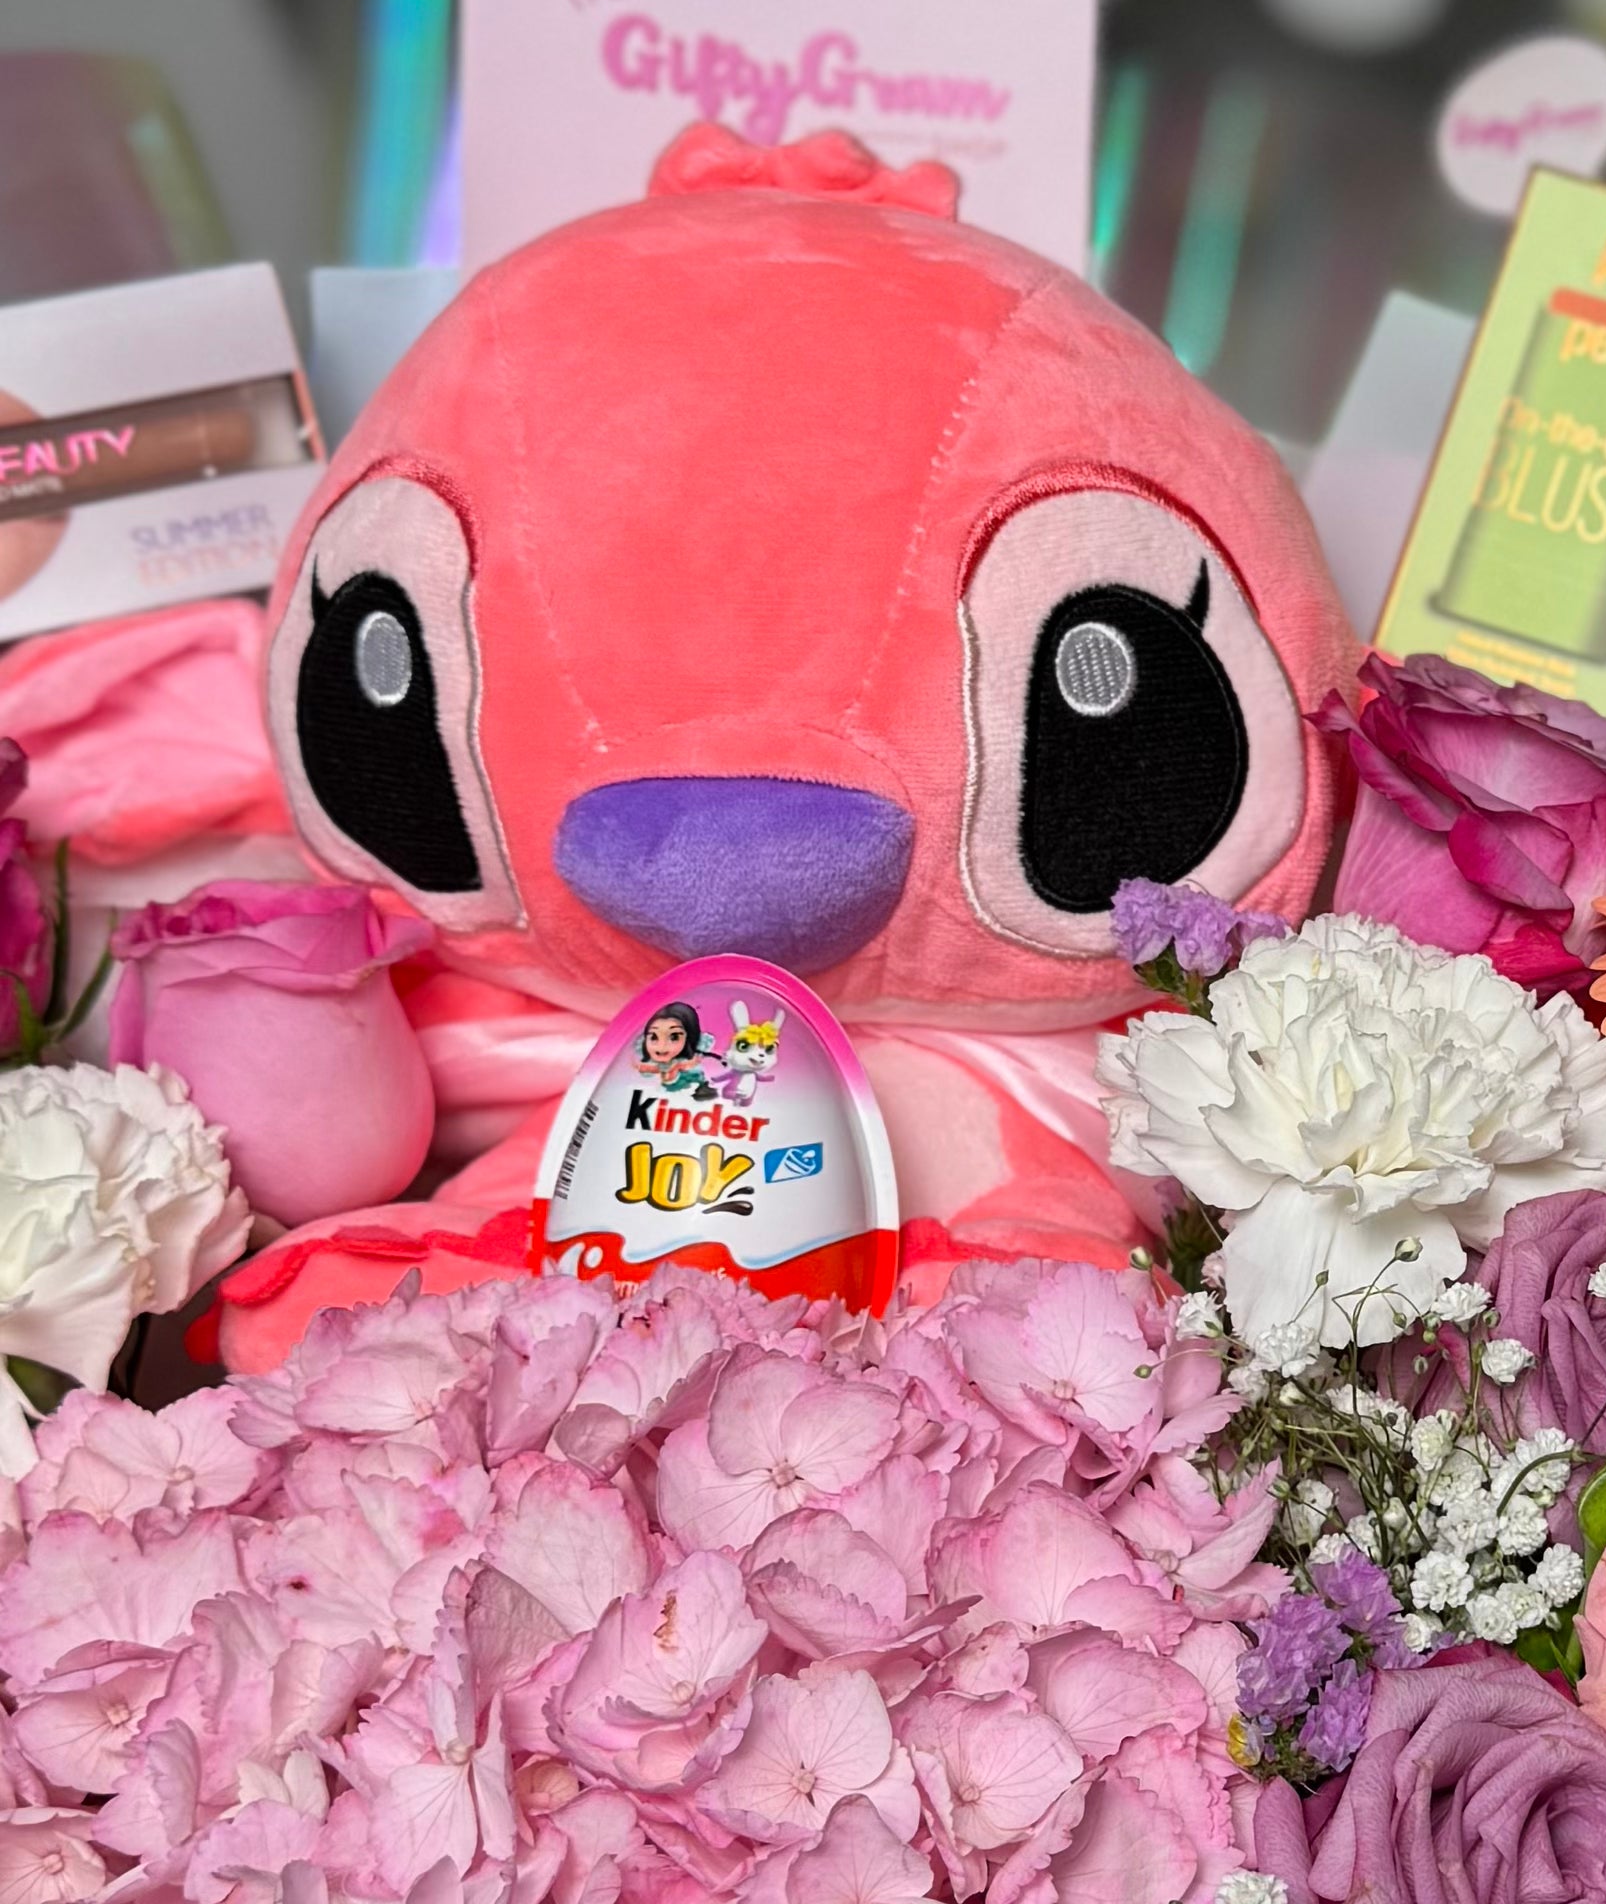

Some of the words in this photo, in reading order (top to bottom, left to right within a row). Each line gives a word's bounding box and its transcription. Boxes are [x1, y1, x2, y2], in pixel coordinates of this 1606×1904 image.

[131, 504, 273, 549] SUMMER
[625, 1089, 771, 1142] Kinder
[614, 1141, 756, 1212] JOY
